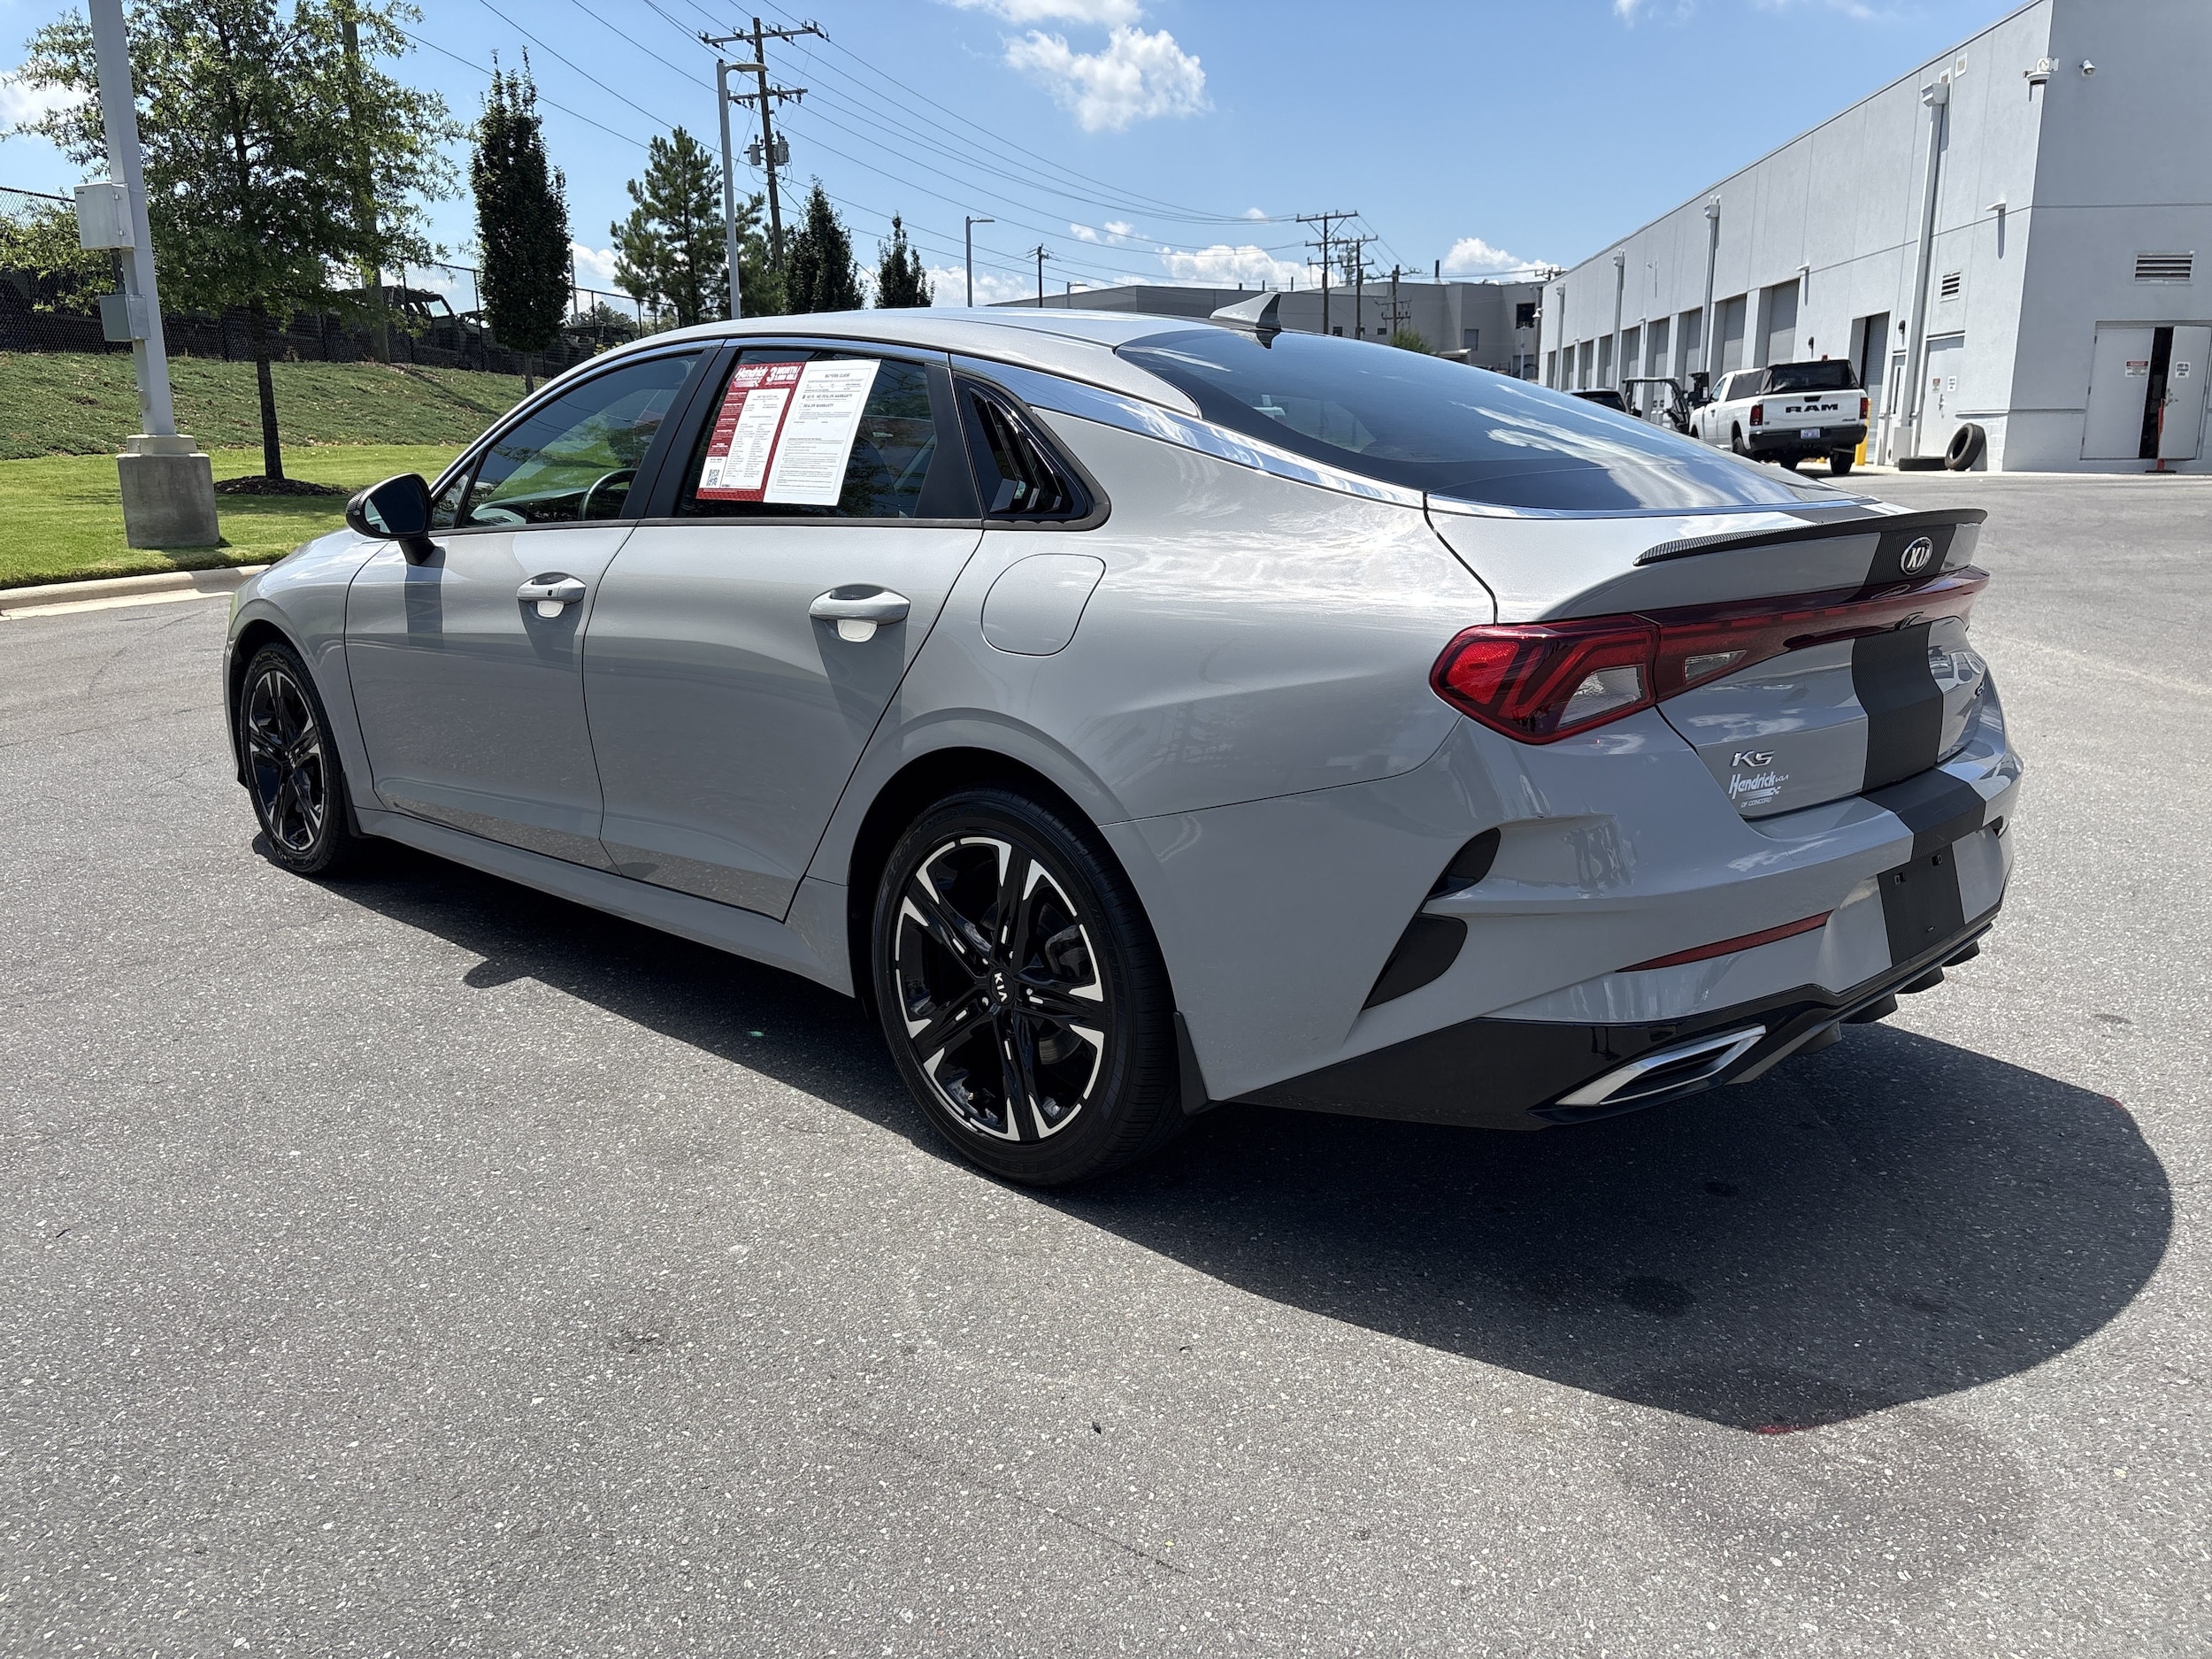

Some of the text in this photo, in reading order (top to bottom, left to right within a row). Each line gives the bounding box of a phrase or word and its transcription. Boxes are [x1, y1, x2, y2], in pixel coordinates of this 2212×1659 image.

[766, 366, 778, 382] 3
[1786, 403, 1839, 413] RAM
[1728, 772, 1776, 800] Hendrick
[994, 972, 1008, 1002] KIA
